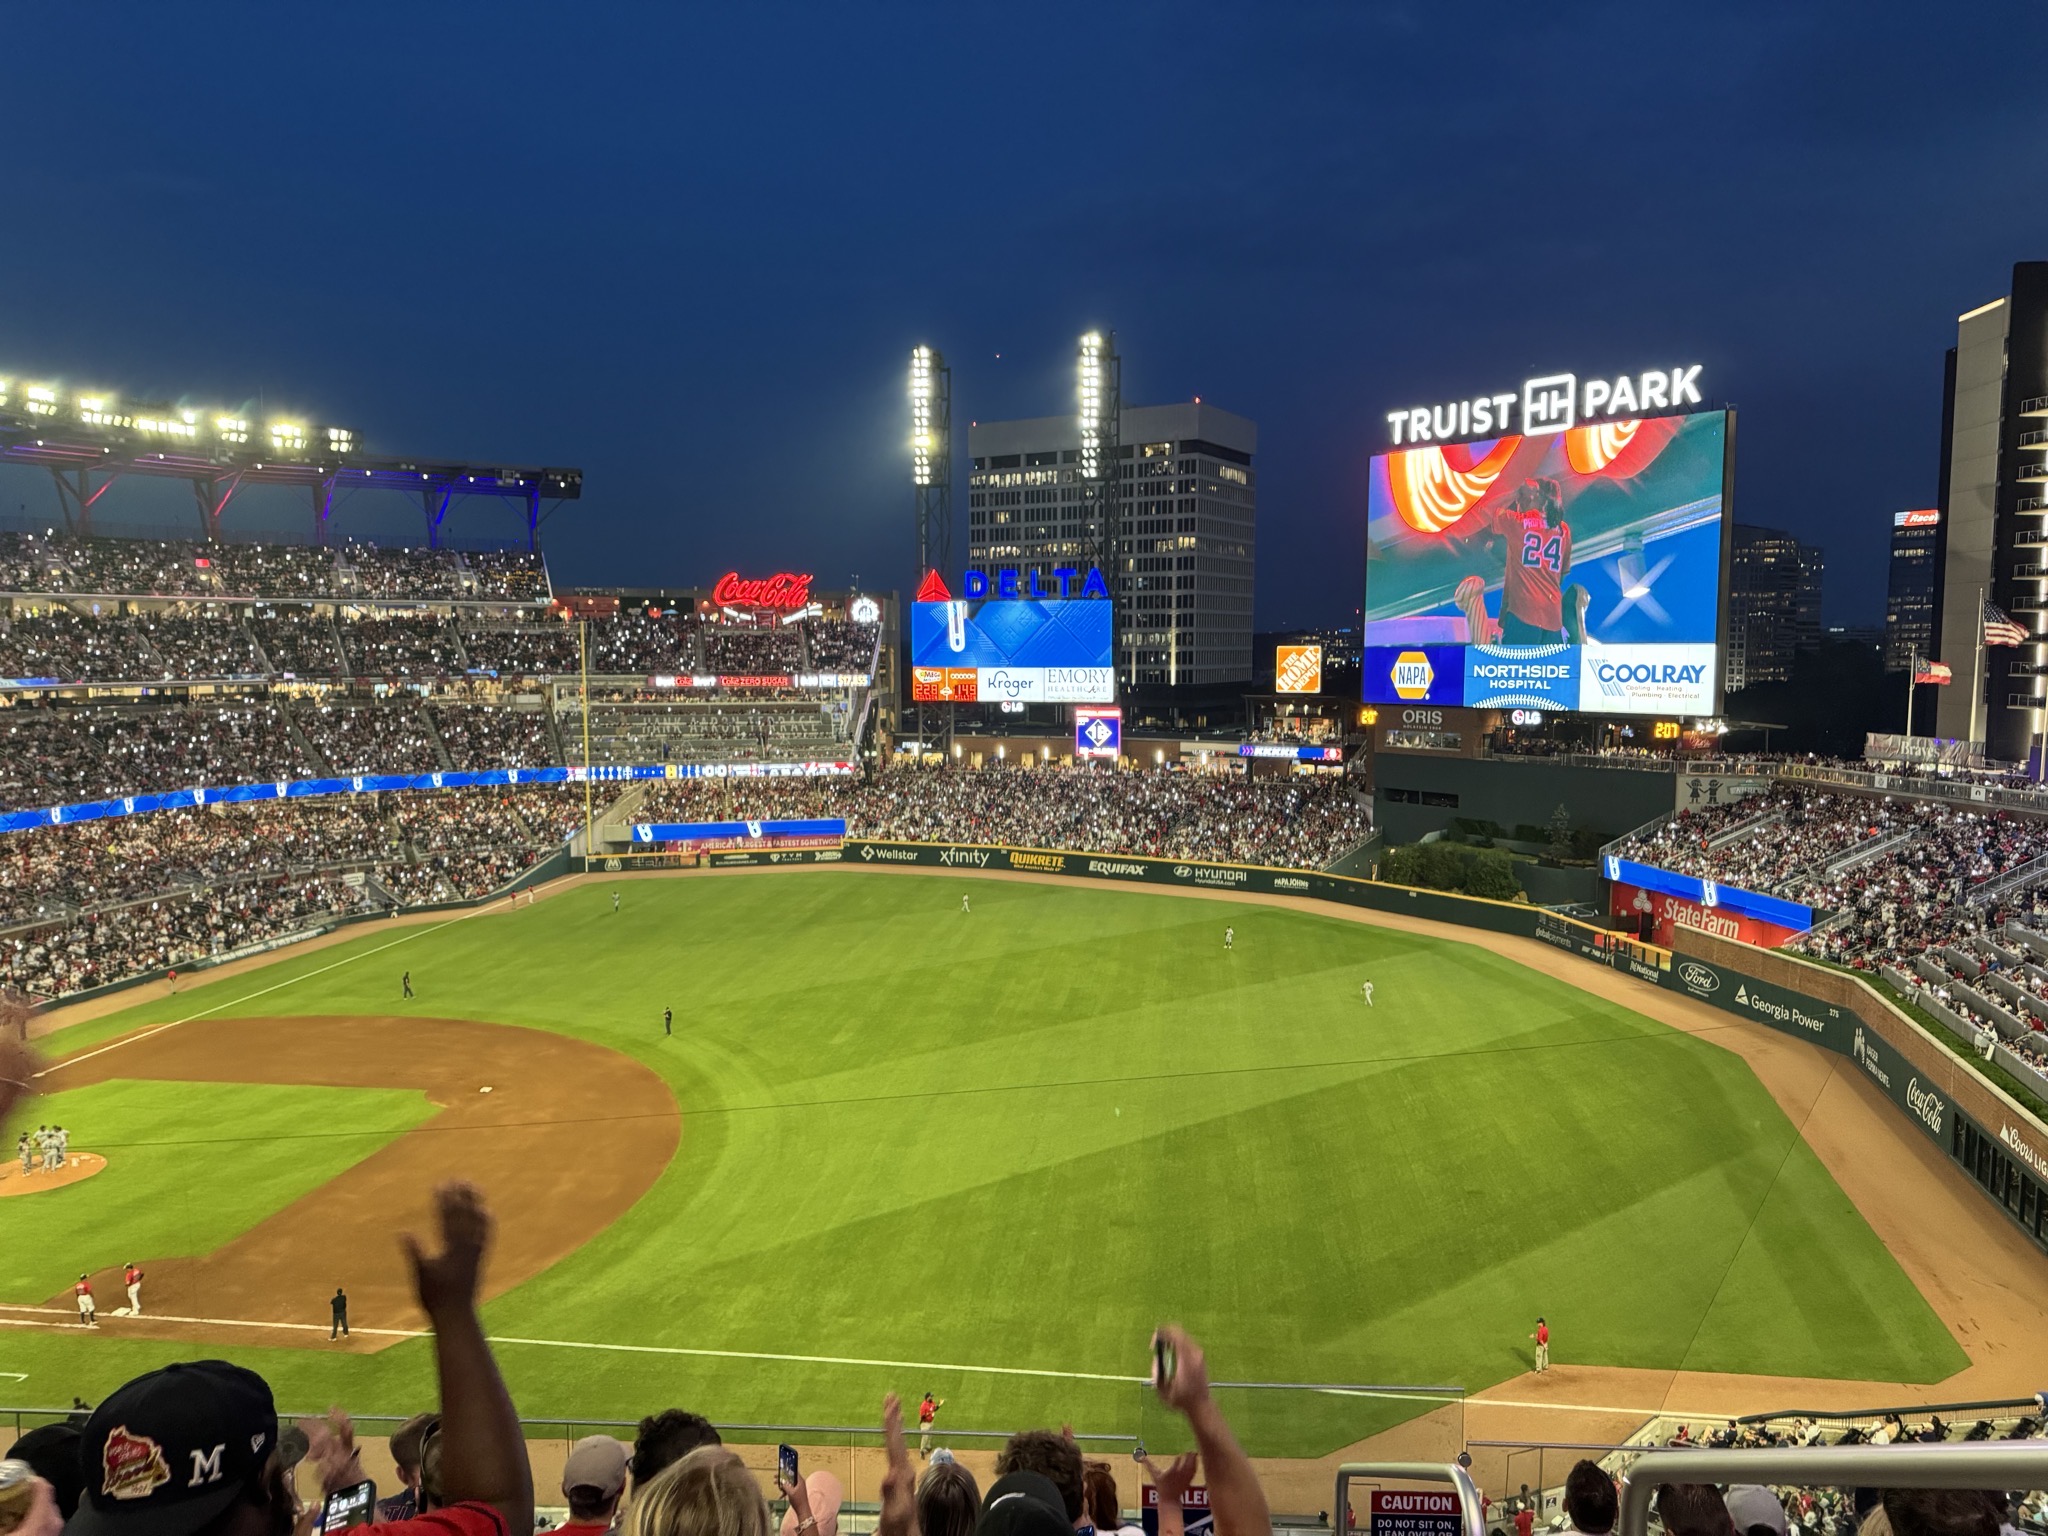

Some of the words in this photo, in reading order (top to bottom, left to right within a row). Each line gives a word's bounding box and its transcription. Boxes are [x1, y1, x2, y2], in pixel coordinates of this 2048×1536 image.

[1387, 393, 1518, 446] TRUIST
[1585, 365, 1703, 418] PARK
[1522, 531, 1561, 572] 24
[713, 572, 813, 607] Coca-Cola
[964, 568, 1109, 599] DELTA
[1048, 669, 1109, 684] EMORY
[1279, 647, 1319, 690] HOME
[1398, 666, 1427, 685] NAPA
[1474, 665, 1570, 679] NORTHSIDE
[1598, 664, 1707, 684] COOLRAY
[538, 674, 551, 684] 42
[722, 676, 740, 686] Coke
[762, 677, 788, 686] SUGAR
[988, 671, 1034, 697] Kroger
[1490, 680, 1551, 690] HOSPITAL
[916, 684, 938, 695] 228
[643, 717, 682, 733] HANK
[1402, 709, 1442, 725] ORIS
[1525, 713, 1542, 726] LG
[1655, 723, 1679, 738] 2:07
[1901, 741, 1940, 758] Braves
[876, 849, 918, 861] Wellstar
[940, 847, 990, 868] xfinity
[1010, 852, 1064, 867] QUIKRETE
[1089, 860, 1145, 875] EQUIFAX
[1195, 868, 1247, 881] HYUNDAI
[1274, 878, 1288, 886] PAPA
[1637, 964, 1659, 979] National
[1685, 966, 1712, 988] Ford
[1751, 994, 1789, 1020] Georgia
[1792, 1008, 1824, 1032] Power
[1907, 1077, 1944, 1133] Coca-Cola
[2010, 1126, 2033, 1163] Coors
[188, 1443, 225, 1487] M
[1381, 1495, 1452, 1511] CAUTION
[1378, 1520, 1392, 1528] DO
[1395, 1520, 1415, 1528] NOT
[1419, 1521, 1434, 1529] SIT
[1437, 1521, 1455, 1530] ON,
